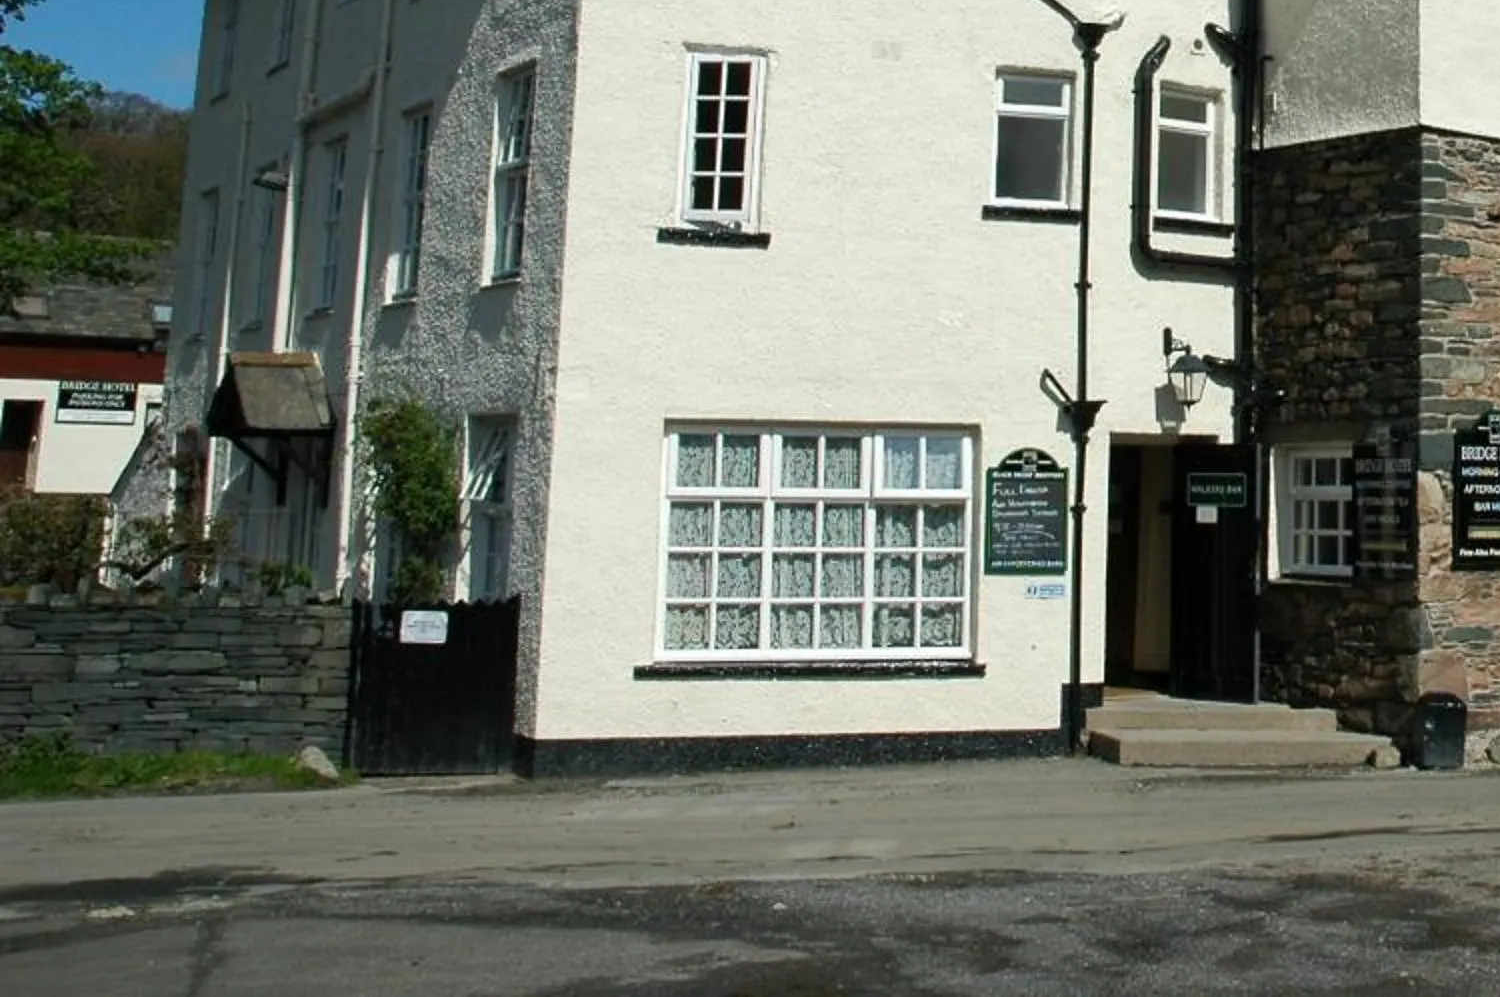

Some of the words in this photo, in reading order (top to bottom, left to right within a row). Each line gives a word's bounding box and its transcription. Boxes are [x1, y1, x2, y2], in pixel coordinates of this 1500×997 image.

[1461, 445, 1498, 461] BRIDGE
[1461, 466, 1499, 478] MORNING
[1473, 501, 1491, 513] BAR
